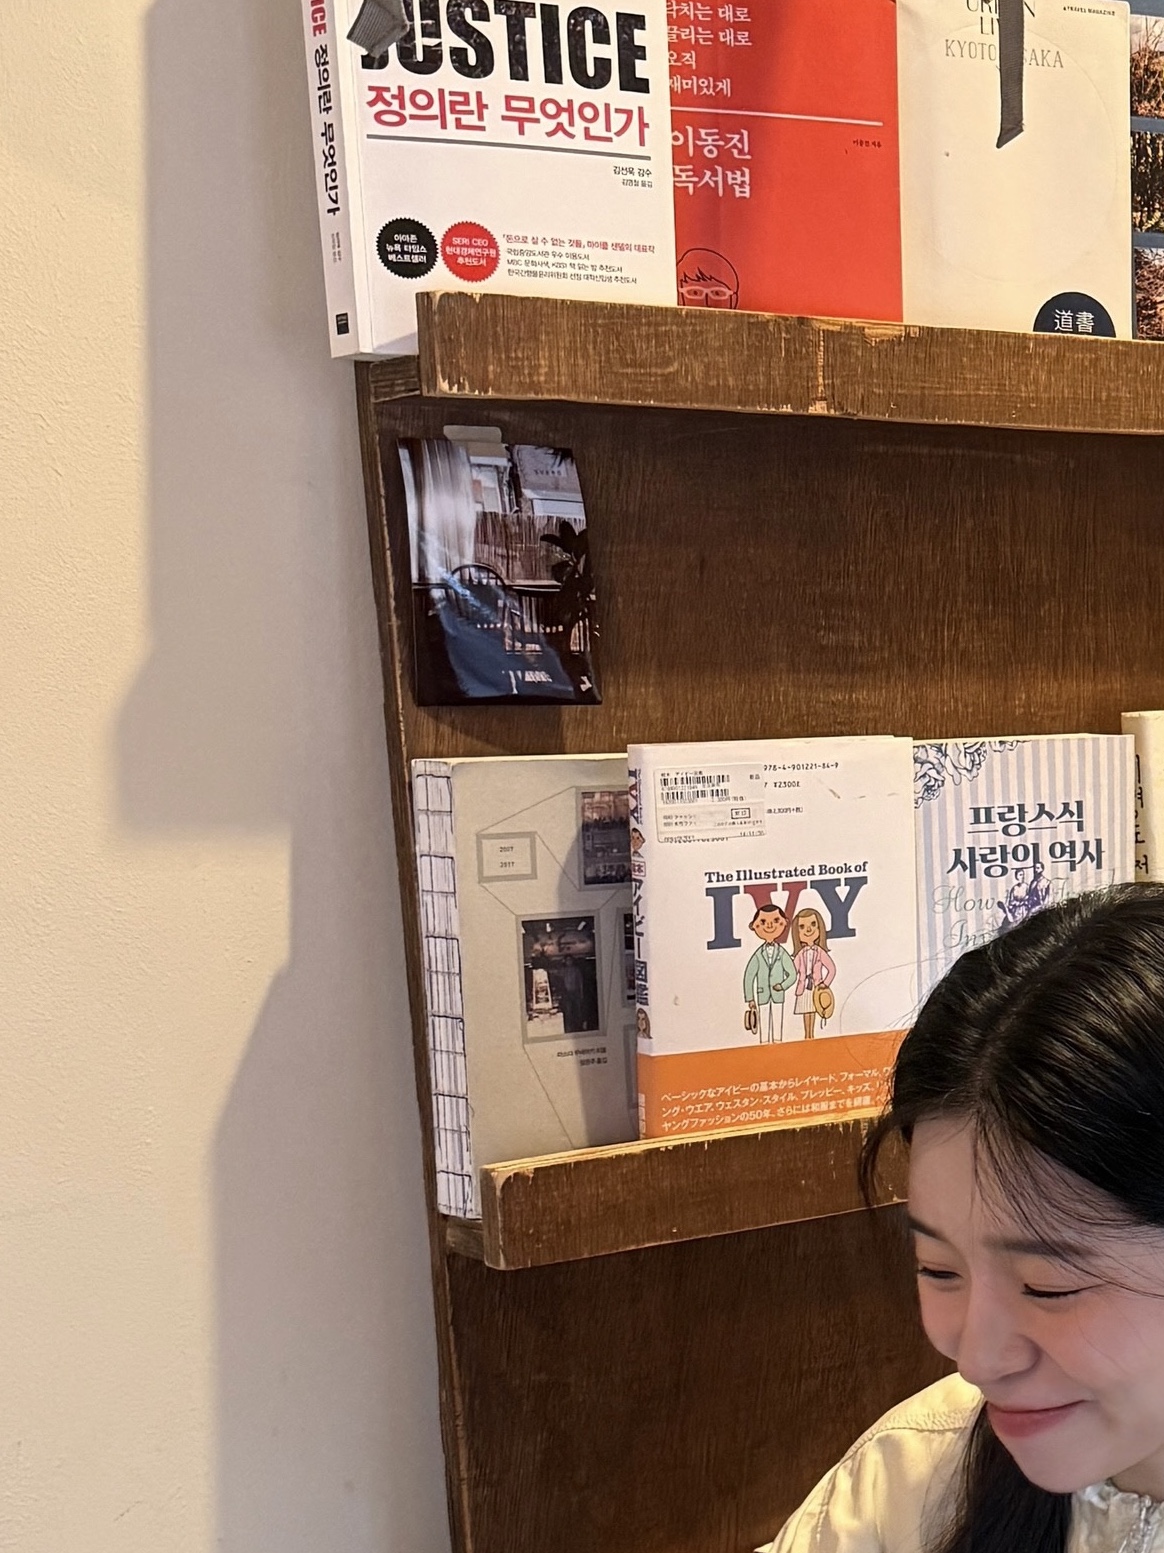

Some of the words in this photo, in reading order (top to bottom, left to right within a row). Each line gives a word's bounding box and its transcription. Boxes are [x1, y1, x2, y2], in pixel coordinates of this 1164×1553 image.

[718, 4, 752, 23] 대로
[361, 0, 650, 94] USTICE
[719, 28, 752, 47] 대로
[945, 39, 997, 61] KYOTO
[668, 50, 696, 69] 오직
[314, 44, 333, 114] 정의란
[669, 75, 731, 97] 재미있게
[366, 85, 489, 132] 정의란
[501, 94, 650, 147] 무엇인가
[671, 125, 752, 160] 이동진
[320, 121, 341, 216] 무엇인가
[673, 165, 751, 198] 독서법
[471, 238, 489, 246] CEO
[551, 237, 566, 247] 없는
[967, 800, 1084, 837] 프랑스식
[705, 871, 734, 883] The
[736, 864, 816, 881] Illustrated
[818, 862, 853, 876] Book
[855, 861, 868, 872] of
[946, 843, 1041, 879] 사랑의
[1049, 838, 1105, 872] 역사
[705, 876, 868, 950] IVY
